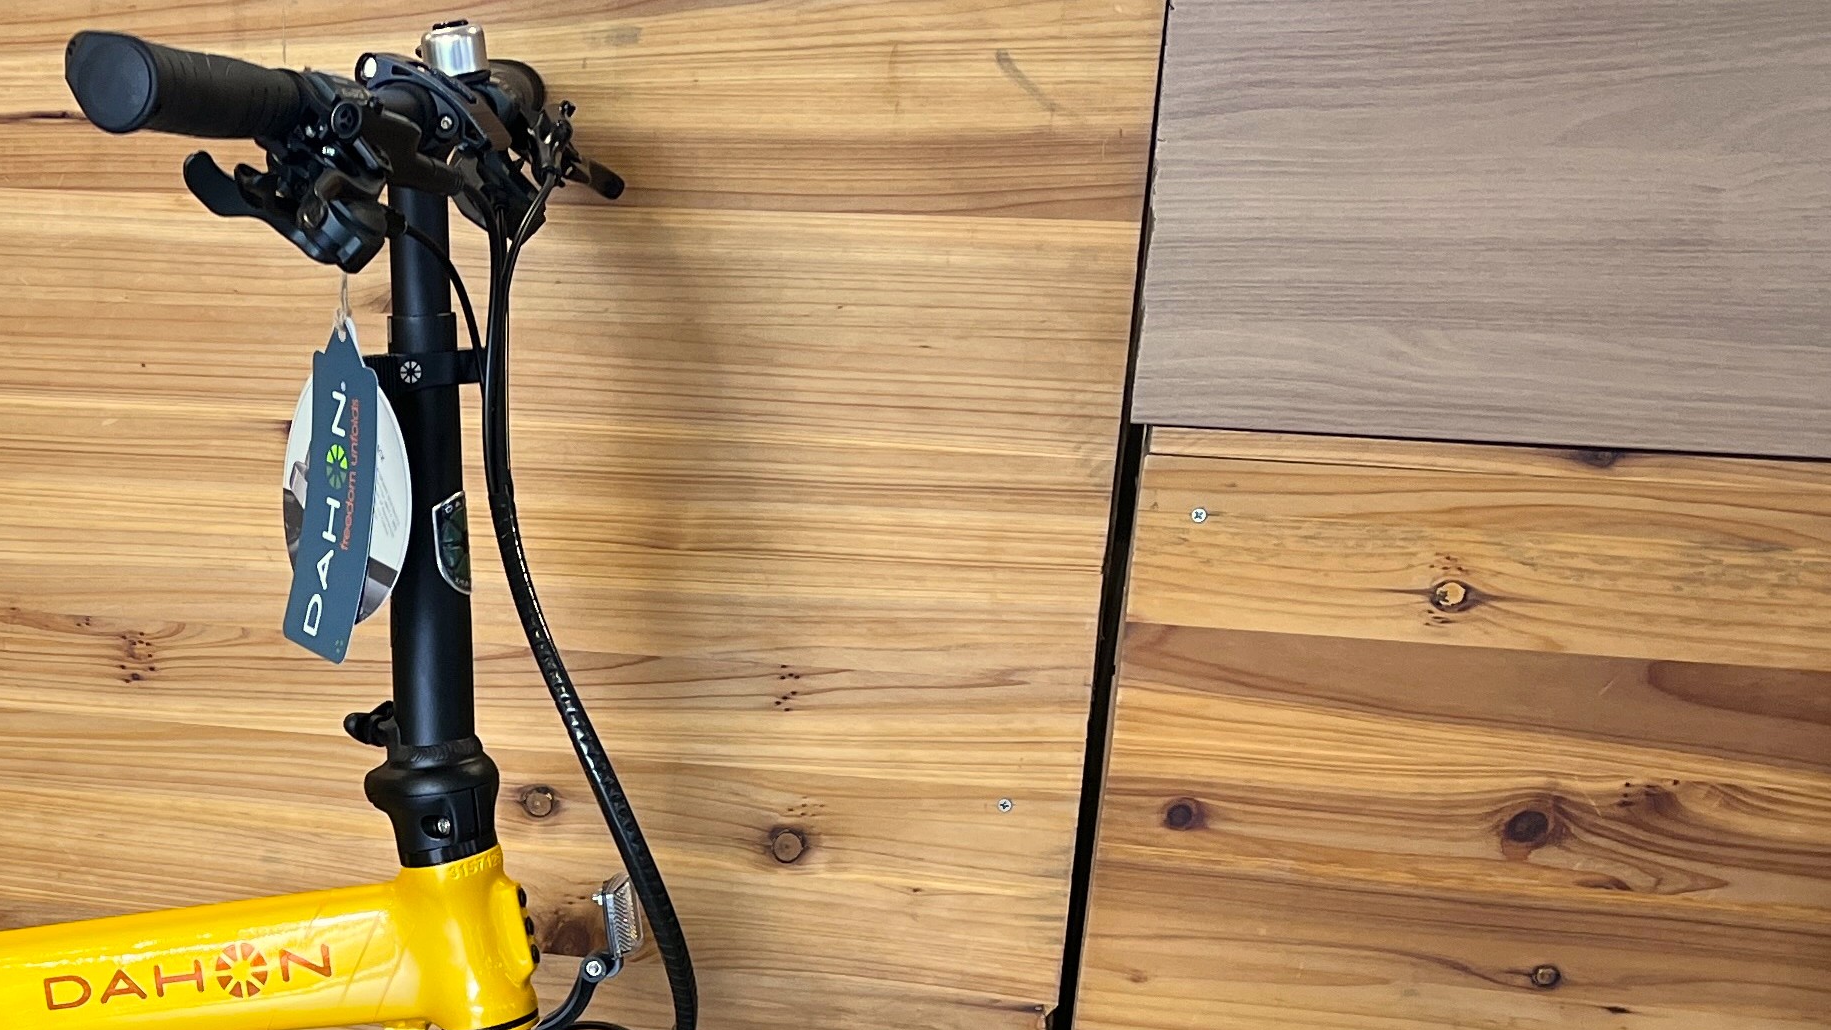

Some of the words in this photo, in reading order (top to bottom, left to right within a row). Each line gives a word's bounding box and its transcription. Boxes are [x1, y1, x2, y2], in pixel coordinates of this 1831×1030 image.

[349, 398, 360, 466] unfolds
[303, 390, 348, 637] DAHON
[340, 471, 356, 550] freedom
[43, 942, 332, 1010] DAHON
